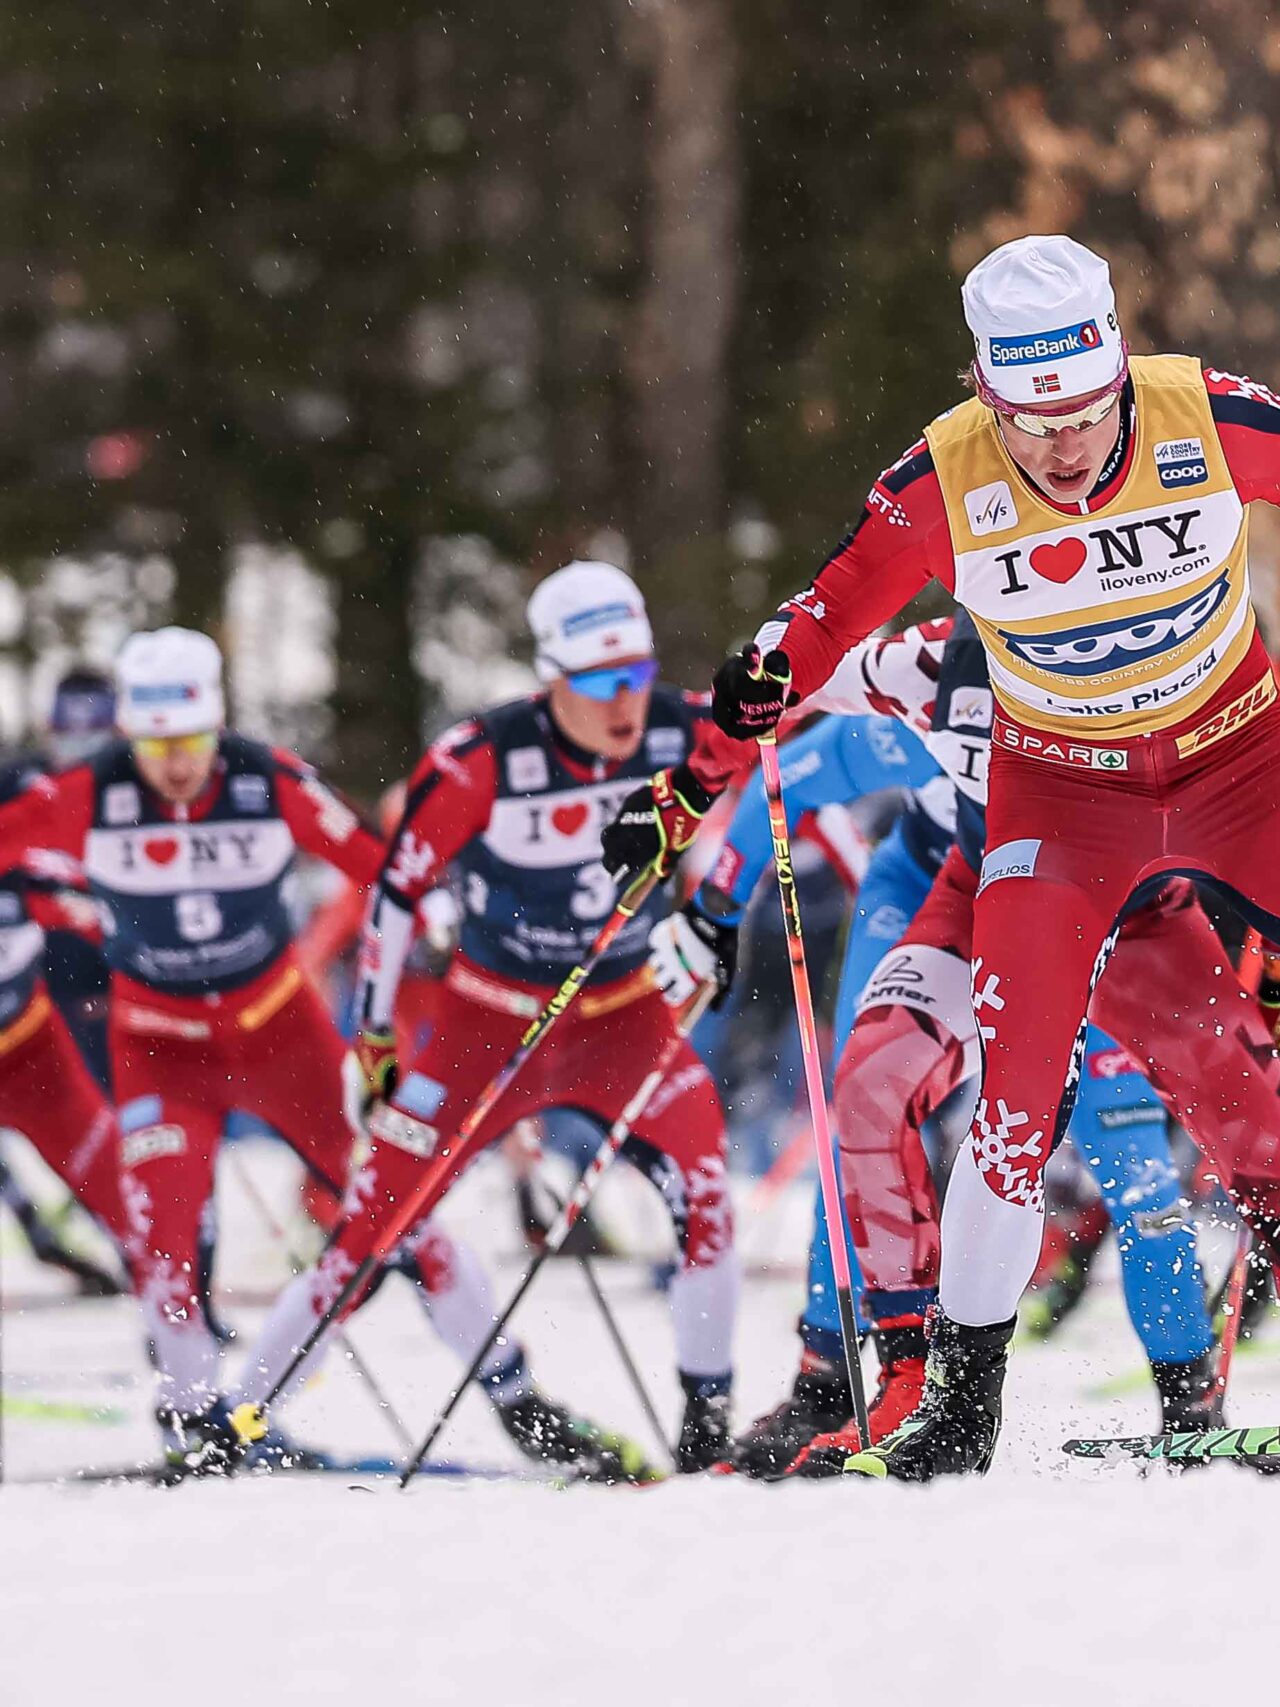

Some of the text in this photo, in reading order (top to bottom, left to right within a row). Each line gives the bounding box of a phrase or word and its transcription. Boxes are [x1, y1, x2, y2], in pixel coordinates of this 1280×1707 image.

[1161, 465, 1206, 480] coop
[995, 509, 1201, 595] I NY
[1100, 554, 1211, 592] iloveny.com
[1014, 582, 1223, 664] coop
[1131, 648, 1217, 710] Placid
[1193, 681, 1272, 746] DHL
[1003, 728, 1091, 763] SPAR
[570, 861, 618, 921] 3
